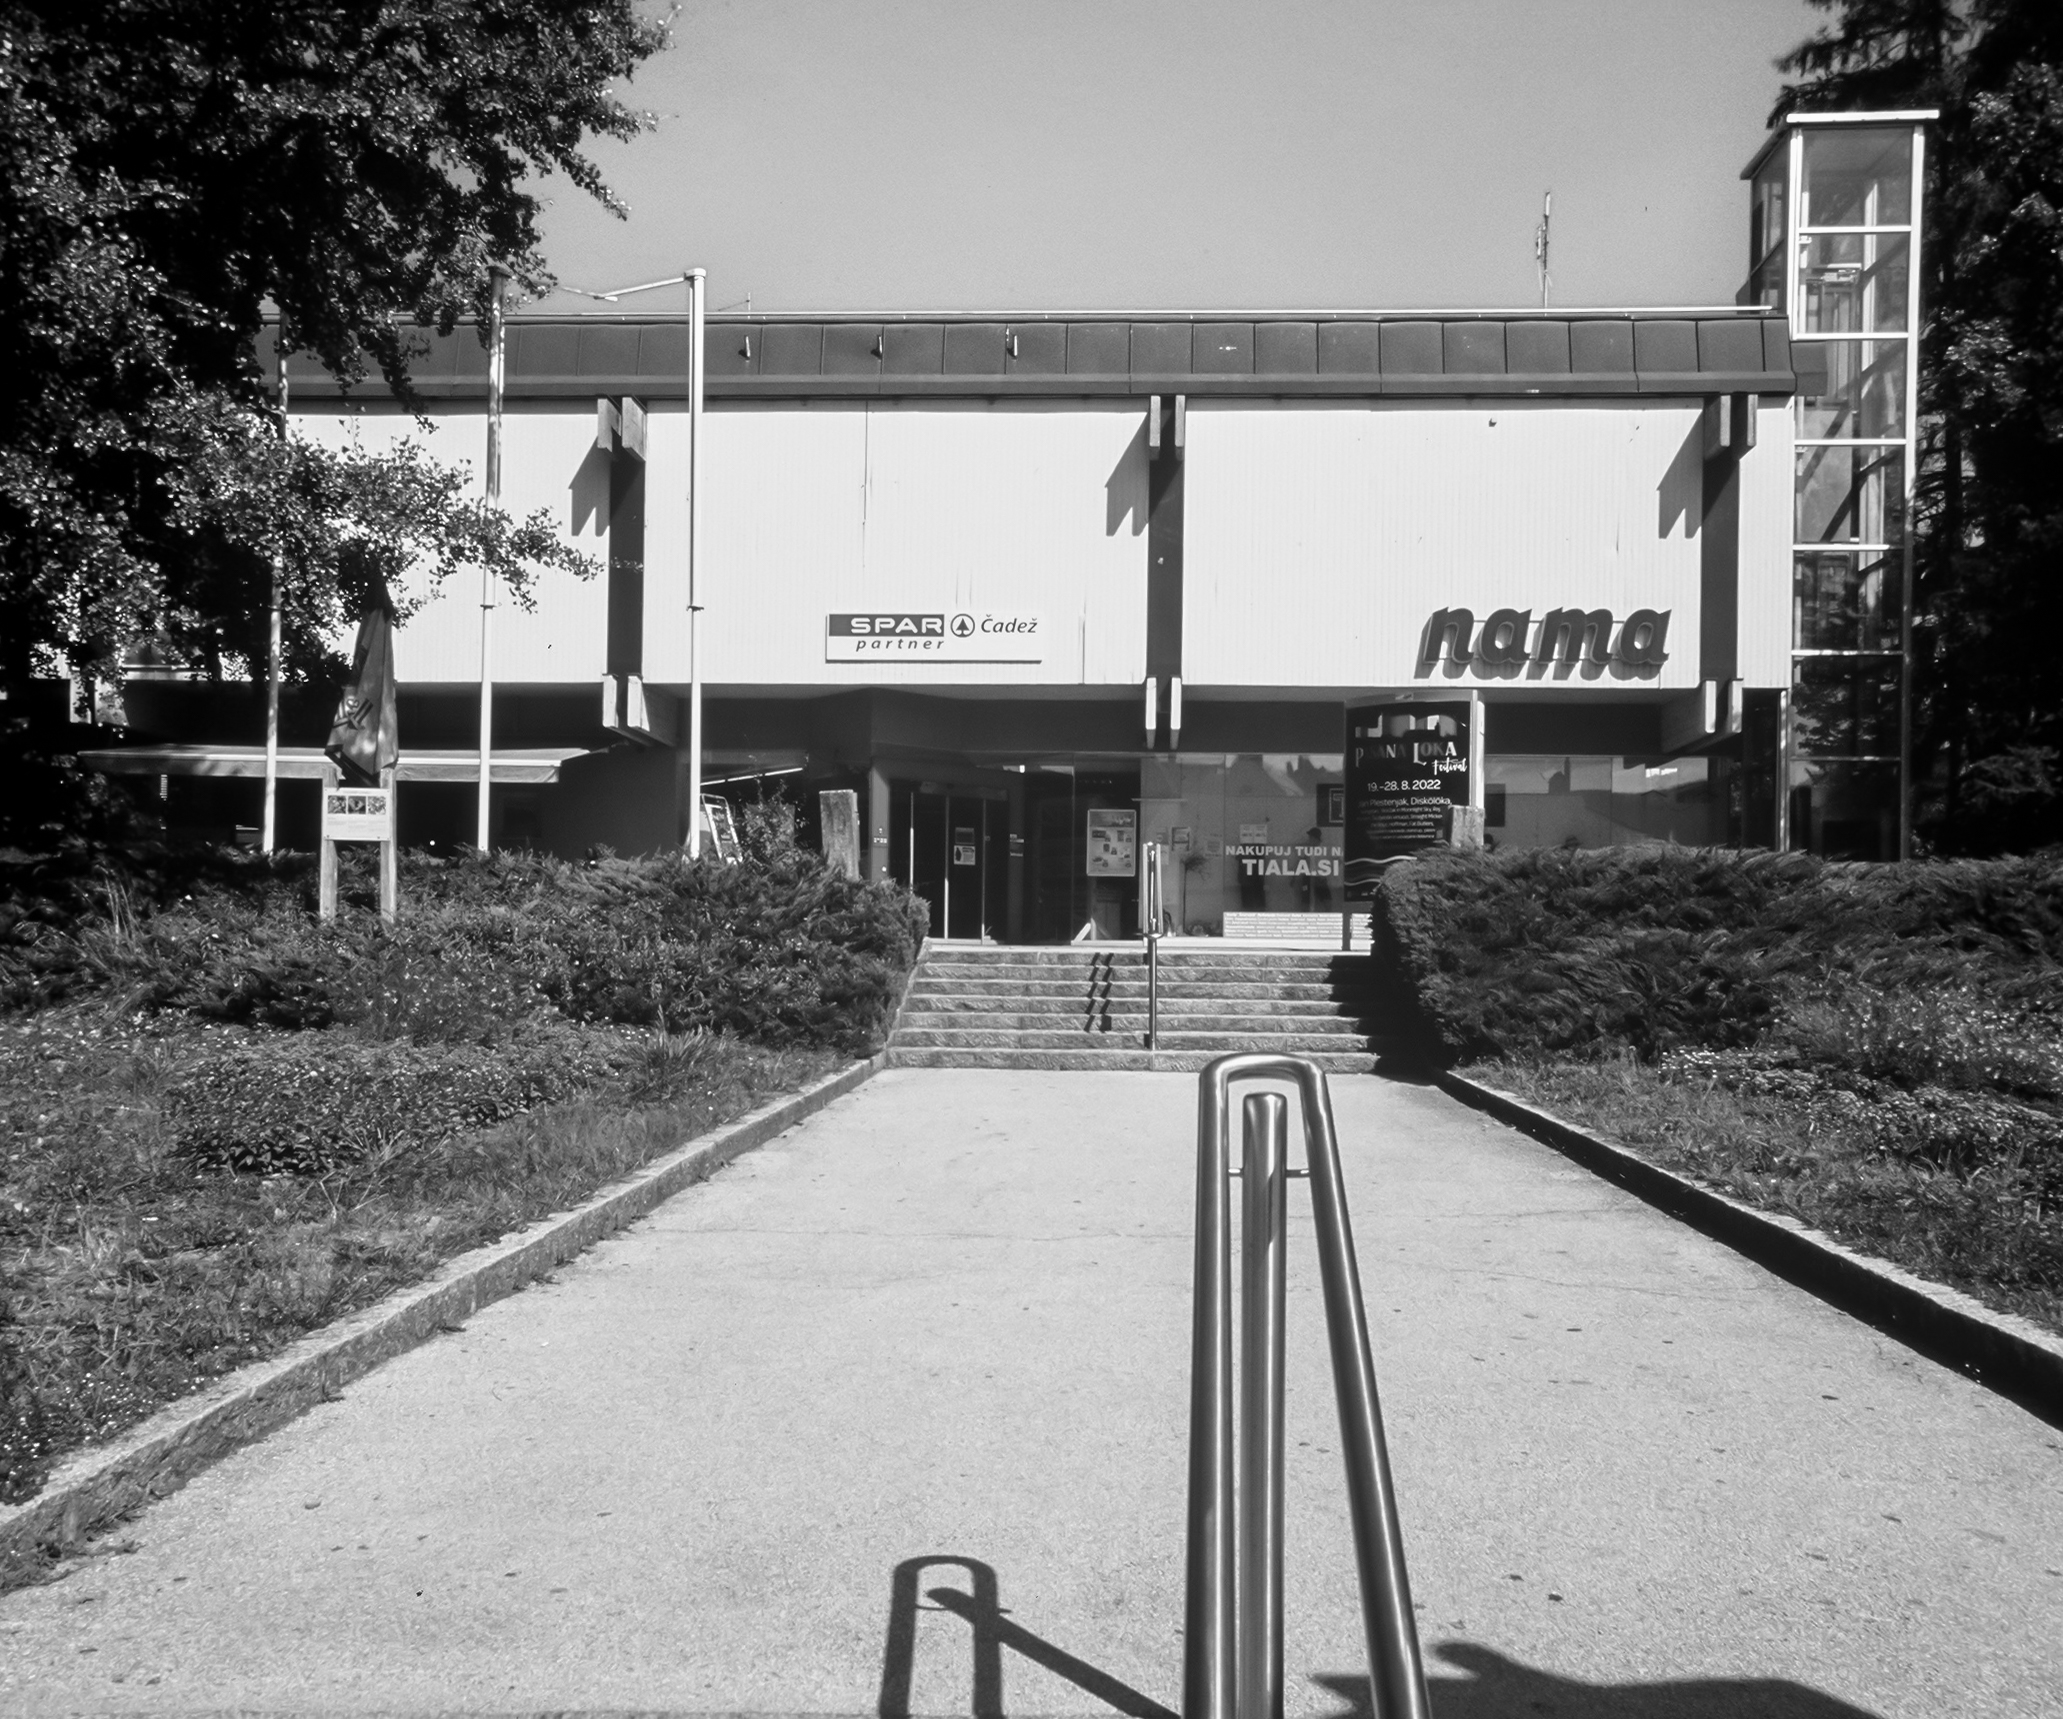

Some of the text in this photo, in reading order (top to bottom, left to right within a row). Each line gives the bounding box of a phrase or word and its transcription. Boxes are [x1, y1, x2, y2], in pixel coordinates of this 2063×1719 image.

[850, 613, 1039, 635] SPAR Čadež
[855, 637, 945, 652] partner
[1417, 606, 1672, 674] nama
[1412, 741, 1458, 766] LOKA
[1411, 778, 1442, 791] 2022
[1225, 845, 1343, 857] NAKUPUJ TUDI N
[1241, 859, 1340, 877] TIALA.SI
